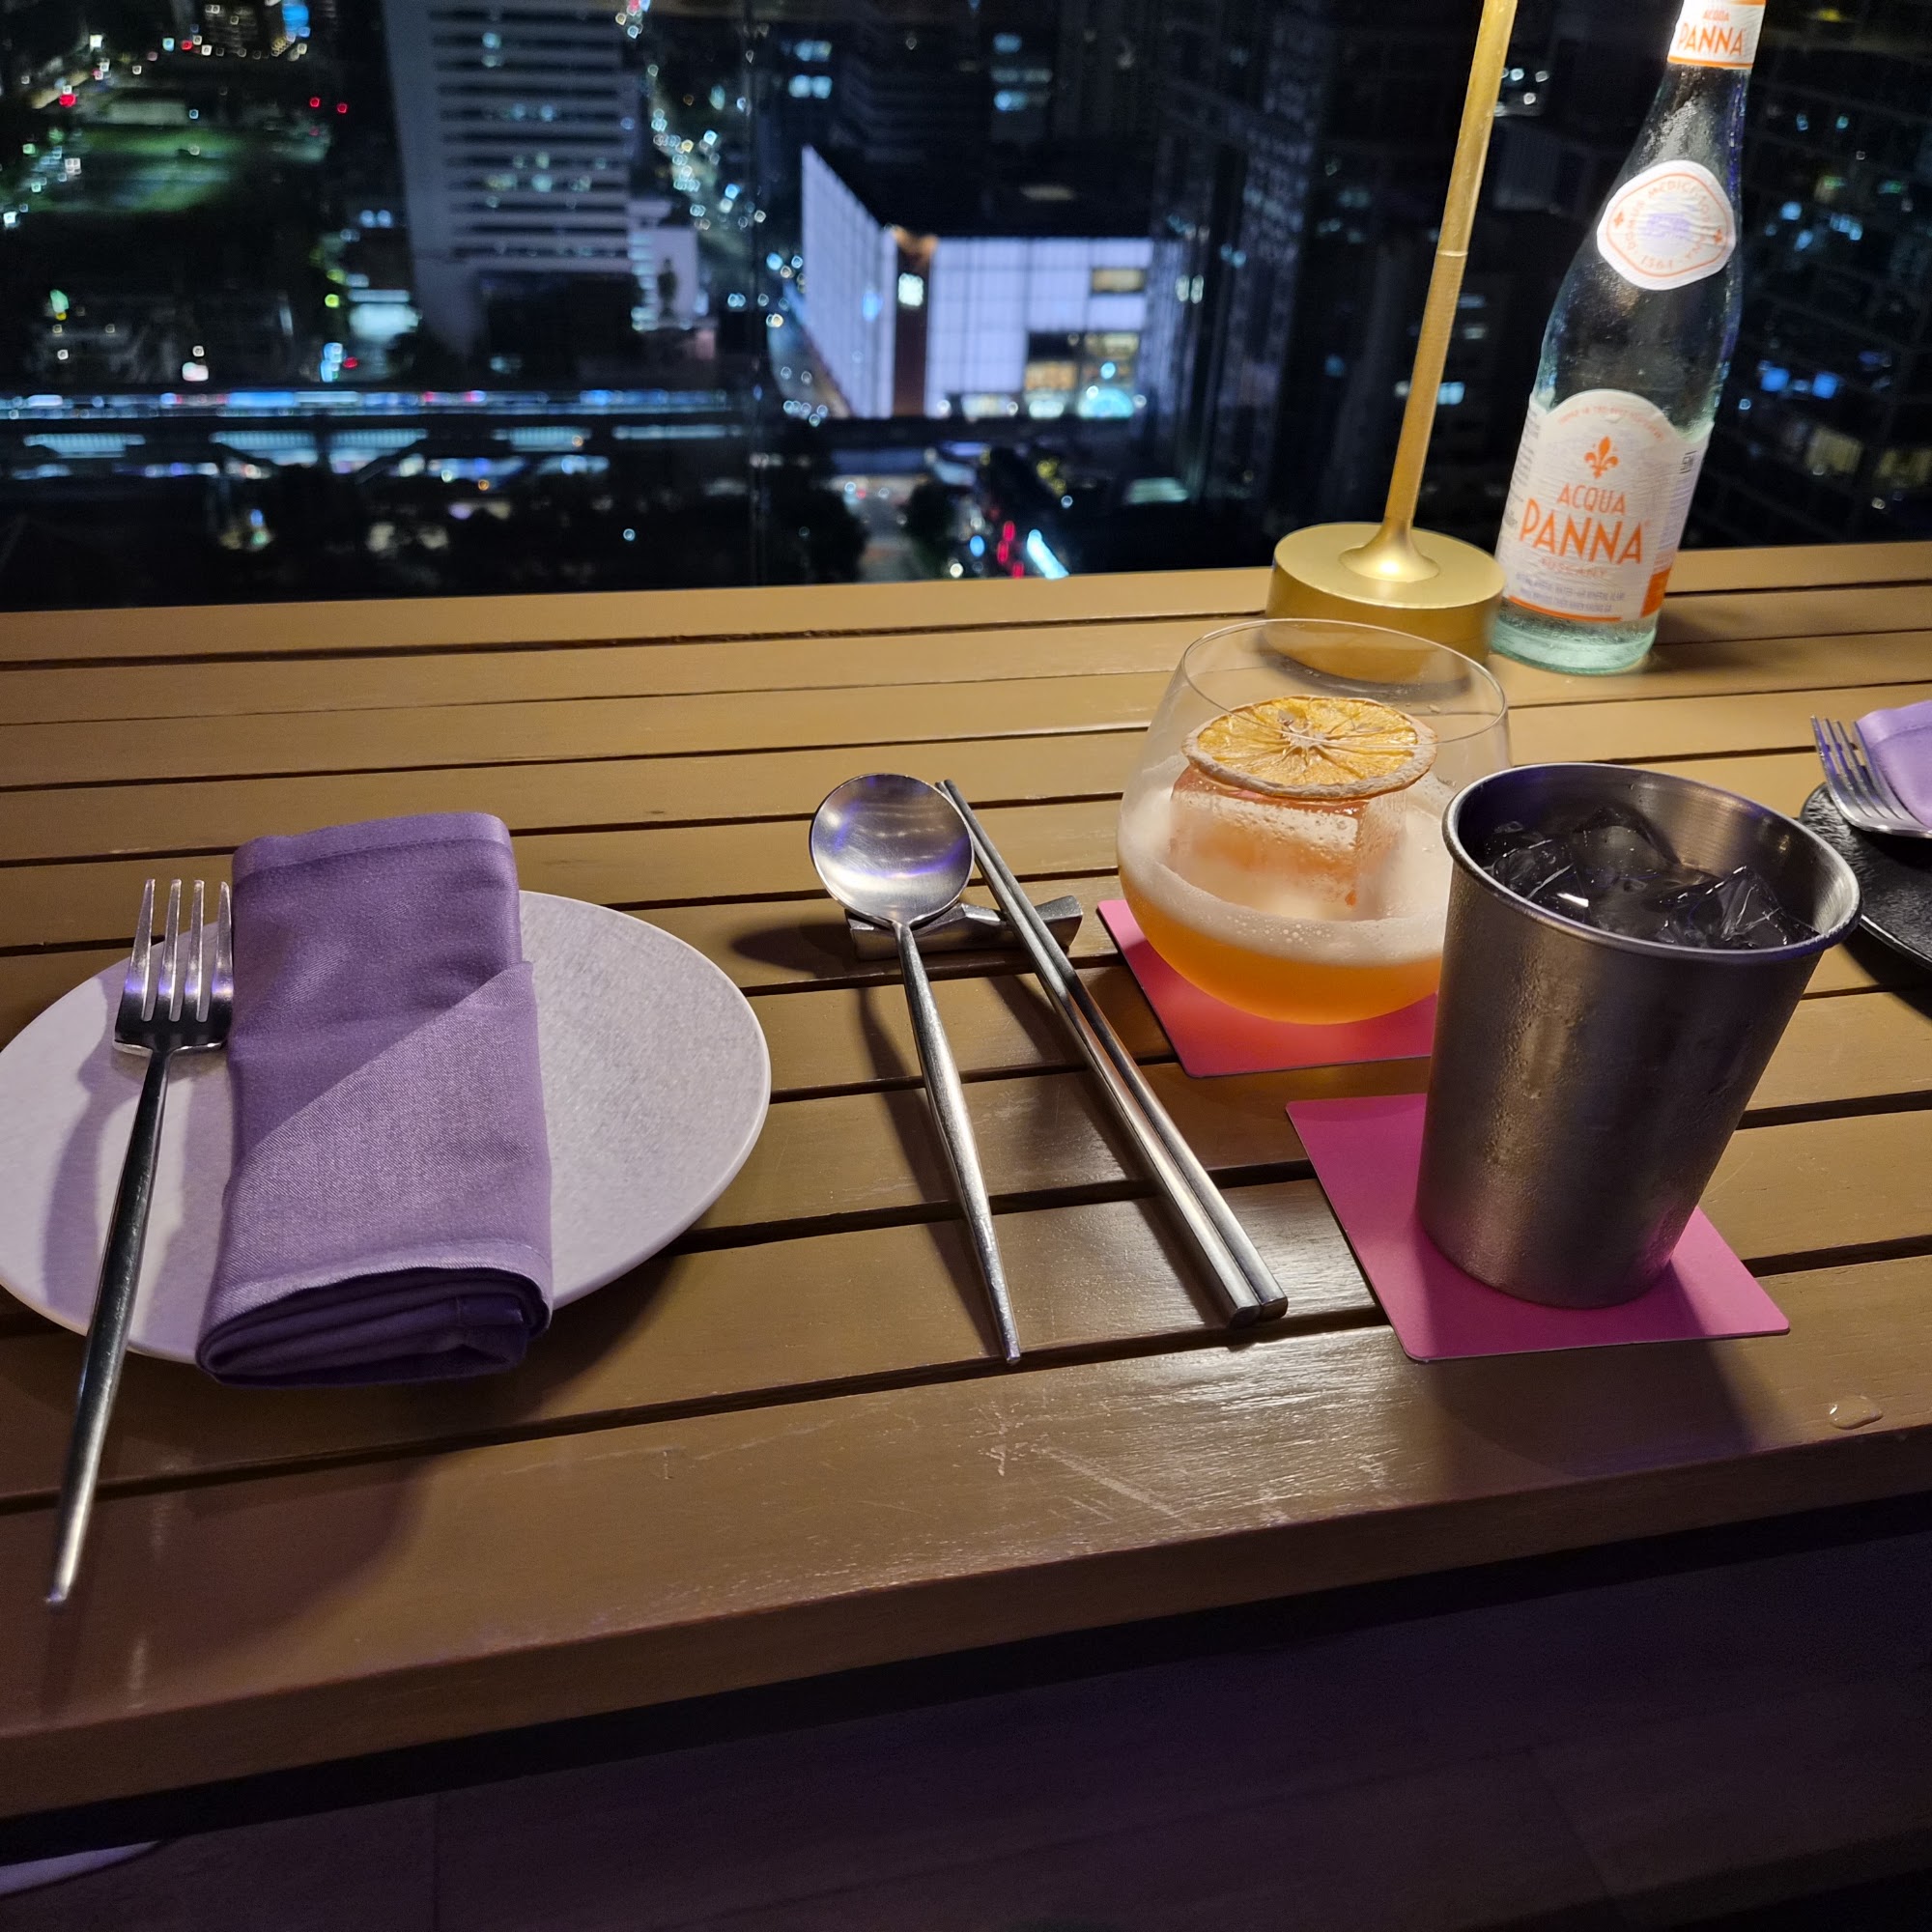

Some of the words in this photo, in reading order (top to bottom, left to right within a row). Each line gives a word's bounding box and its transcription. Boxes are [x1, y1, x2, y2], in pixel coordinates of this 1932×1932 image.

[1677, 22, 1744, 56] PANNA
[1556, 483, 1626, 516] ACQUA
[1520, 497, 1641, 565] PANNA
